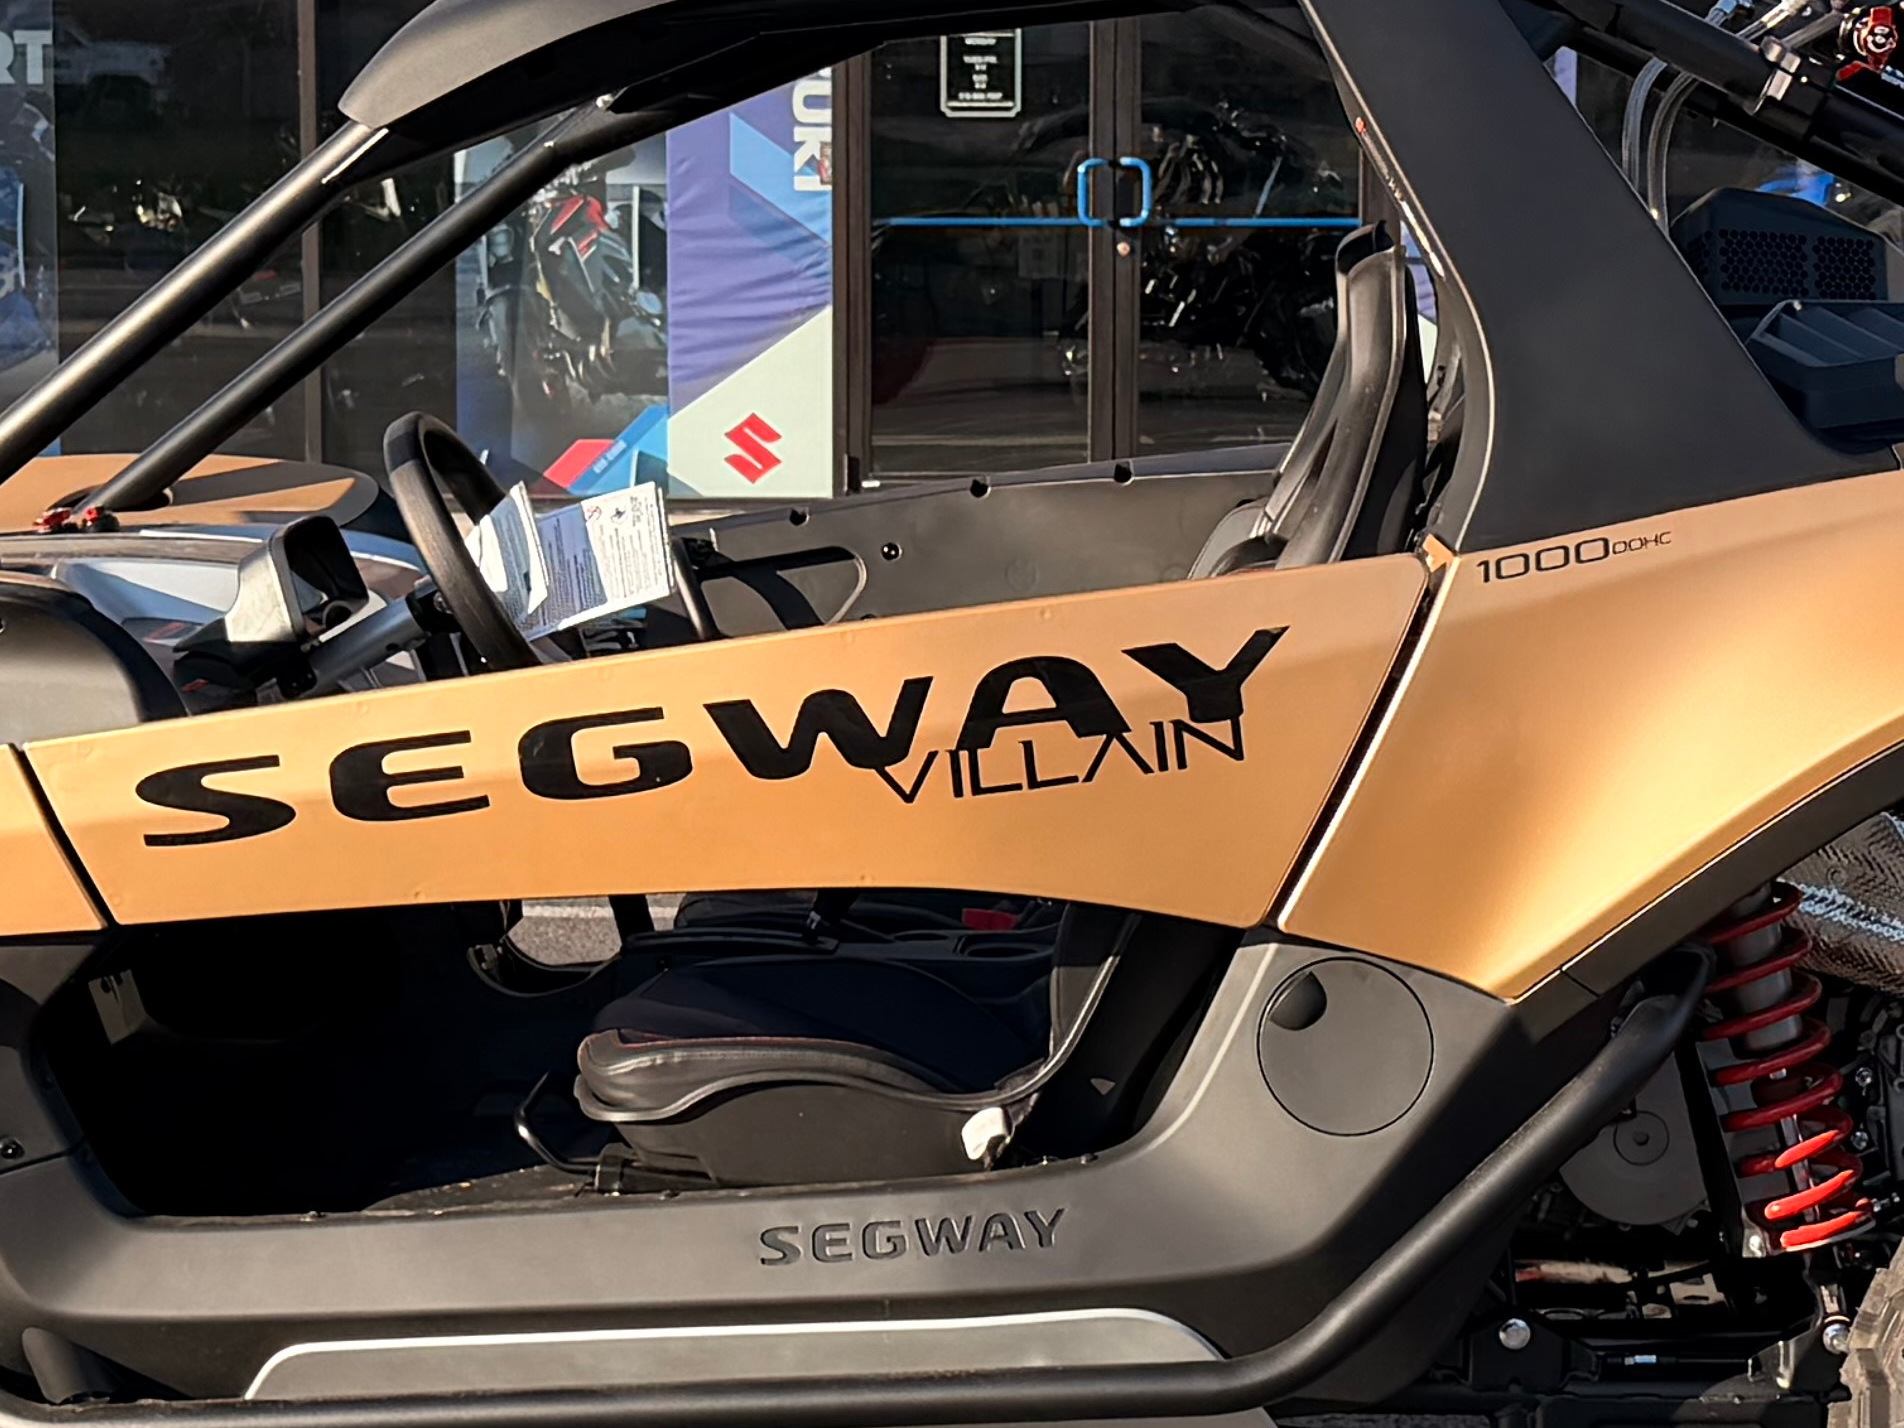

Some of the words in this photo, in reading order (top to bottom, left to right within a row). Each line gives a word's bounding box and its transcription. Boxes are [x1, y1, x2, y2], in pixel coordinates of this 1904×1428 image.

[792, 66, 833, 192] UKI
[134, 625, 1291, 848] SEGWAY
[873, 717, 1246, 804] VILLAIN
[759, 1206, 1068, 1269] SEGWAY
